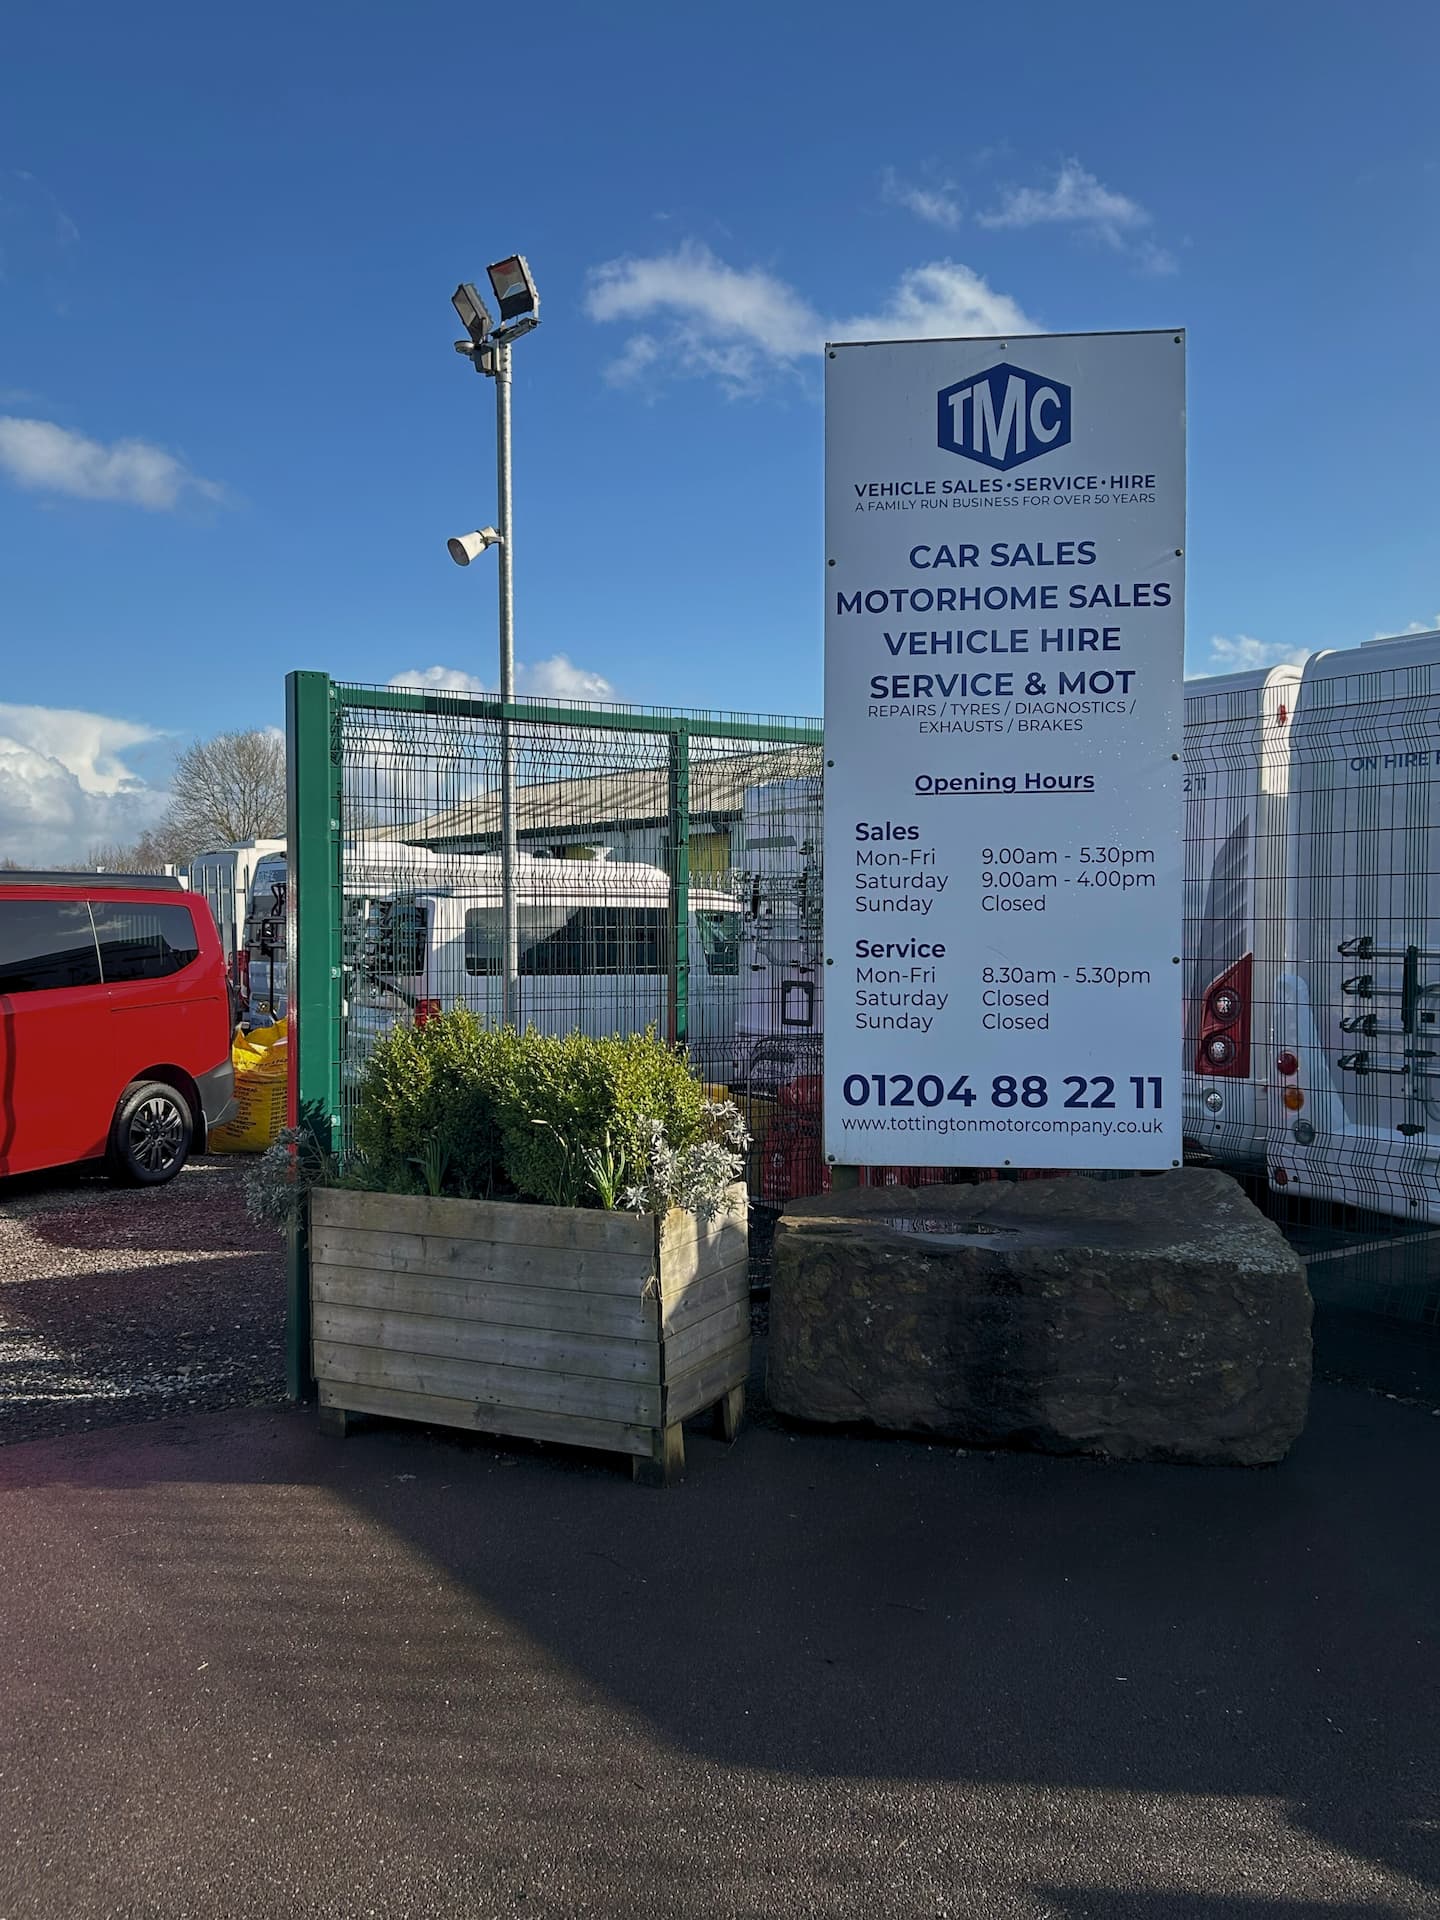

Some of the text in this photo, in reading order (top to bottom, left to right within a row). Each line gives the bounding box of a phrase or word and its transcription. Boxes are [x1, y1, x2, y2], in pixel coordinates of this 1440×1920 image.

[948, 374, 1062, 461] TMC
[854, 481, 936, 497] VEHICLE
[1110, 474, 1156, 489] HIRE
[854, 493, 1156, 513] A FAMILY RUN BUSINESS FOR OVER 50 YEARS
[909, 541, 1097, 569] CAR SALES
[837, 583, 1171, 615] MOTORHOME SALES
[883, 627, 1121, 656] VEHICLE HIRE
[870, 671, 1136, 699] SERVICE & MOT
[868, 704, 937, 718] REPAIRS
[950, 703, 1001, 716] TYRES
[1015, 701, 1126, 715] DIAGNOSTICS
[919, 720, 1004, 734] EXHAUSTS
[1018, 718, 1083, 732] BRAKES
[1351, 758, 1377, 771] ON
[1384, 752, 1429, 768] HIRE
[914, 772, 1096, 794] Opening Hours
[855, 821, 920, 841] Sales
[856, 848, 936, 866] Mon-Fri
[981, 848, 1058, 865] 9.00am
[1079, 847, 1155, 868] 5.30pm
[855, 872, 949, 893] Saturday
[981, 872, 1057, 888] 9.00am
[1076, 871, 1156, 892] 4.00pm
[855, 895, 1046, 916] Sunday Closed
[855, 938, 946, 959] Service
[856, 966, 936, 984] Mon-Fri
[982, 967, 1056, 984] 8.30am
[1075, 967, 1151, 988] 5.30pm
[855, 989, 1049, 1010] Saturday Closed
[855, 1012, 1049, 1033] Sunday Closed
[843, 1074, 1163, 1109] 01204 88 22 11
[841, 1115, 1164, 1137] www.tottingtonmotorcompany.co.uk
